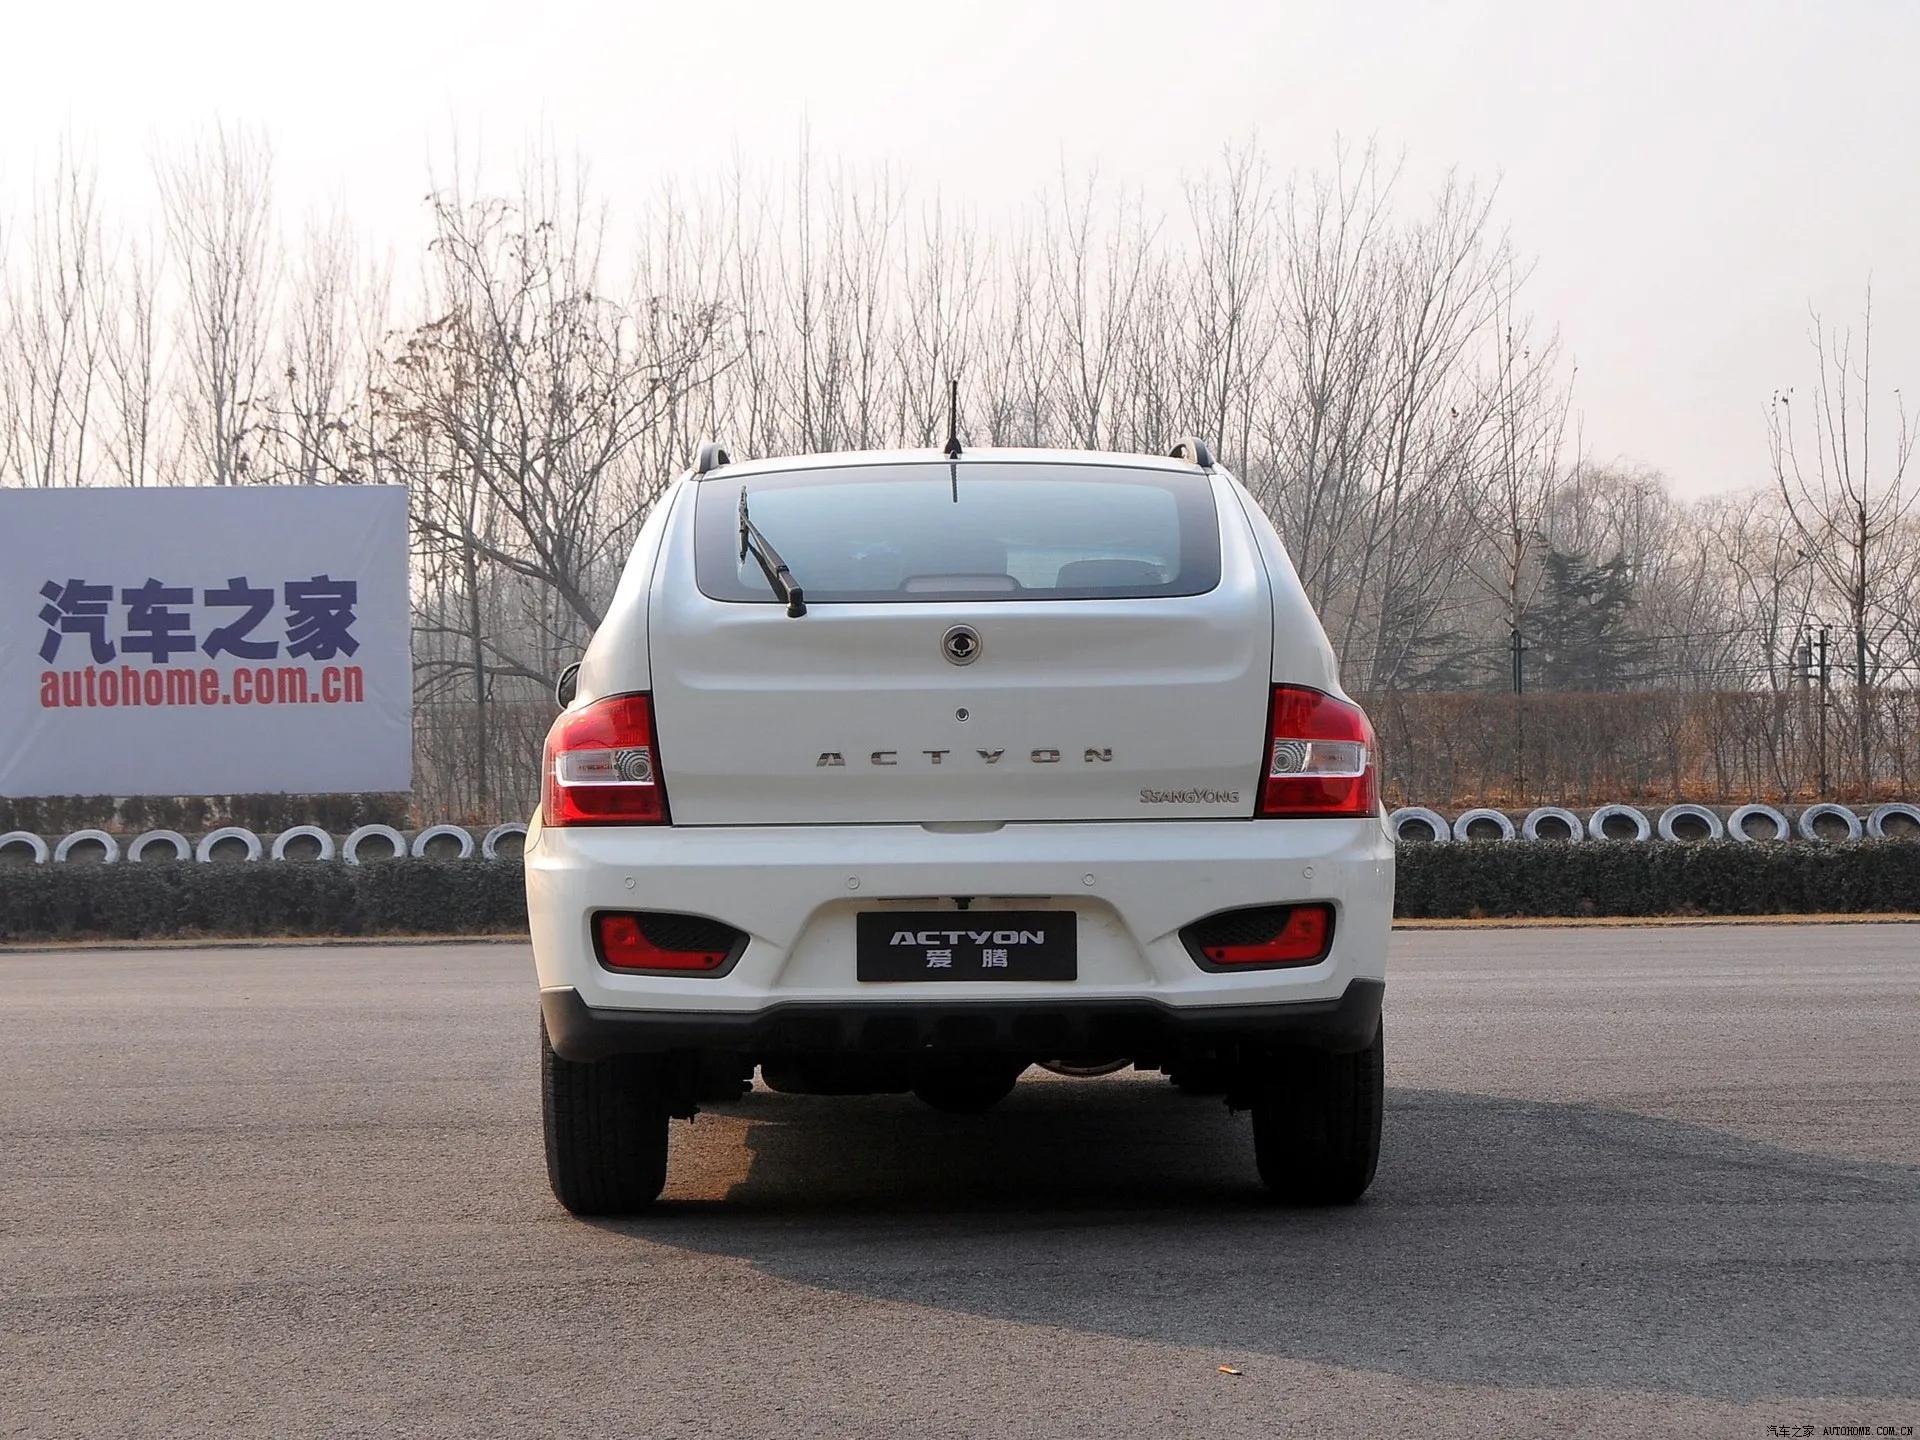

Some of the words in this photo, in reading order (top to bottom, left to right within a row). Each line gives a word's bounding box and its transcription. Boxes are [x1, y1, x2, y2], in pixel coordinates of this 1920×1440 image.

[38, 574, 361, 664] 汽车之家
[40, 664, 364, 708] autohome.com.cn
[816, 747, 1113, 768] ACTYON
[889, 930, 1045, 946] ACTYON
